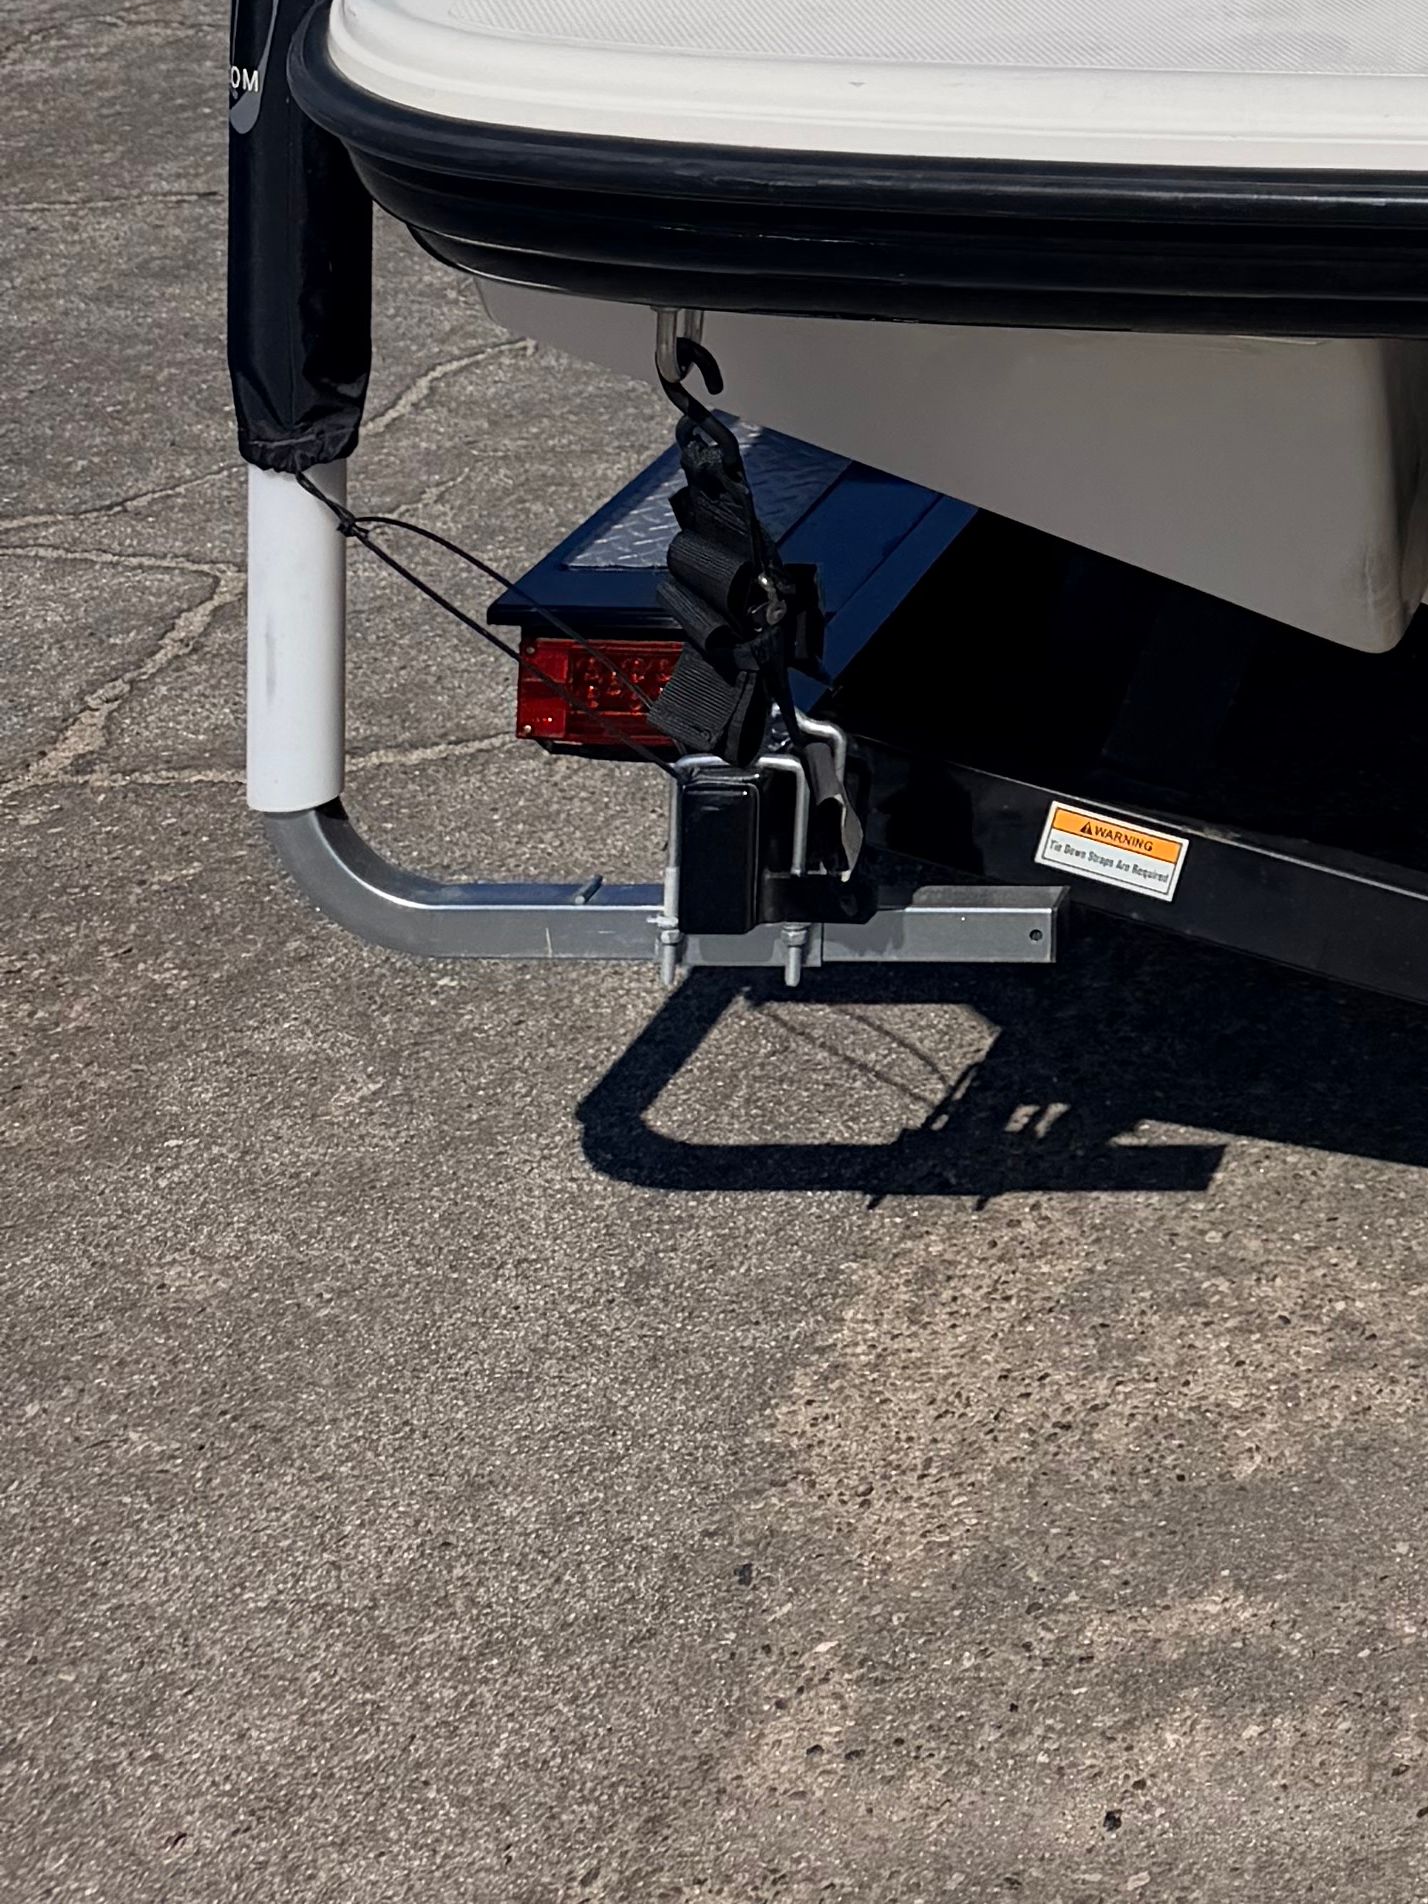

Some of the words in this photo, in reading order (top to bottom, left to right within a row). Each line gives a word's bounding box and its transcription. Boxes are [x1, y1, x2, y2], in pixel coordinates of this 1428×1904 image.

[1094, 824, 1154, 852] WARNING
[1049, 839, 1062, 852] Tie
[1063, 844, 1086, 860] Down
[1087, 850, 1114, 869] Straps
[1115, 859, 1130, 873] Are
[1131, 863, 1170, 884] Required
